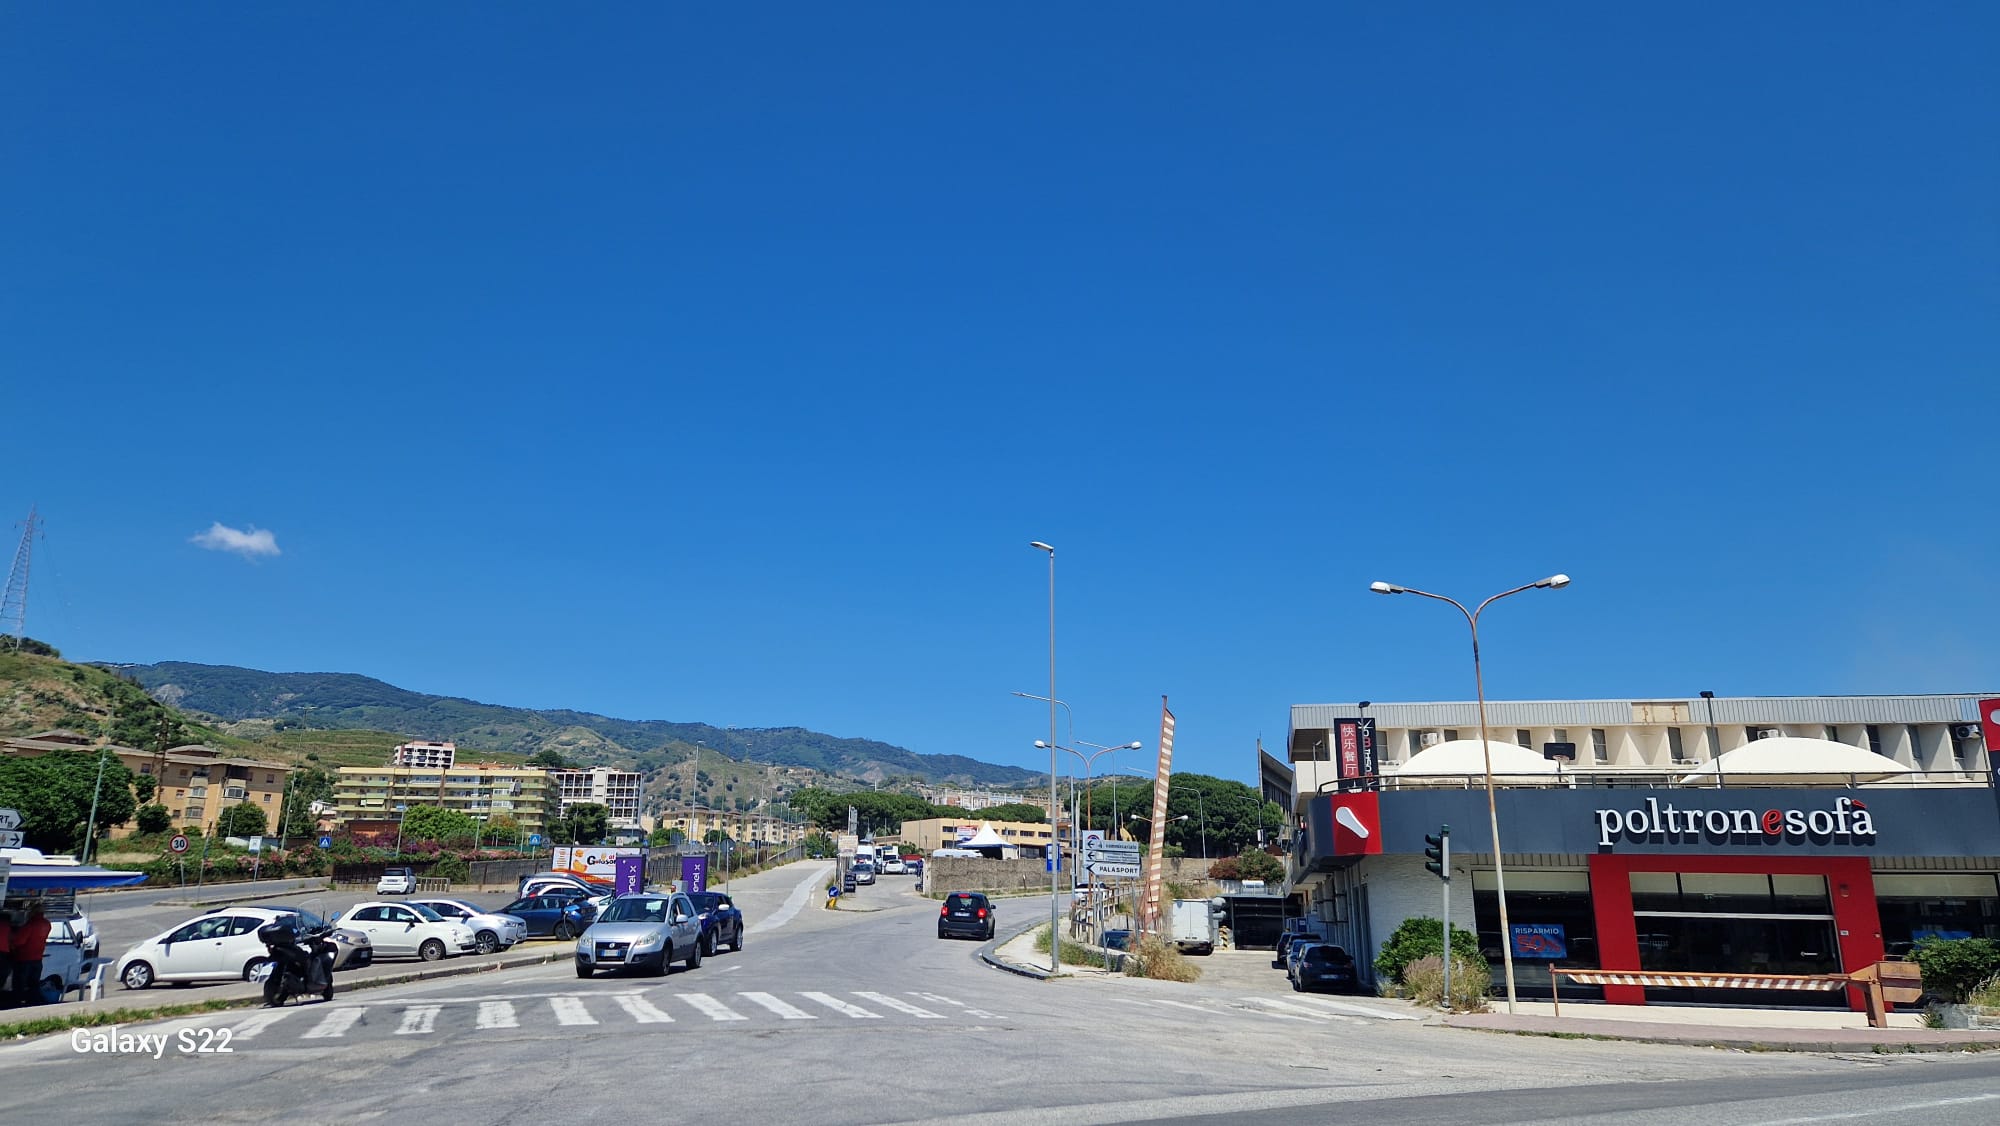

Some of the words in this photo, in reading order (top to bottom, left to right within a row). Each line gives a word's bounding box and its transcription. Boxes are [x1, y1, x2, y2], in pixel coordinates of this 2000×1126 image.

[1343, 725, 1358, 776] 快乐餐厅
[1595, 797, 1877, 846] poltronesofà
[173, 839, 185, 849] 30
[1514, 927, 1560, 935] RISPARMIO
